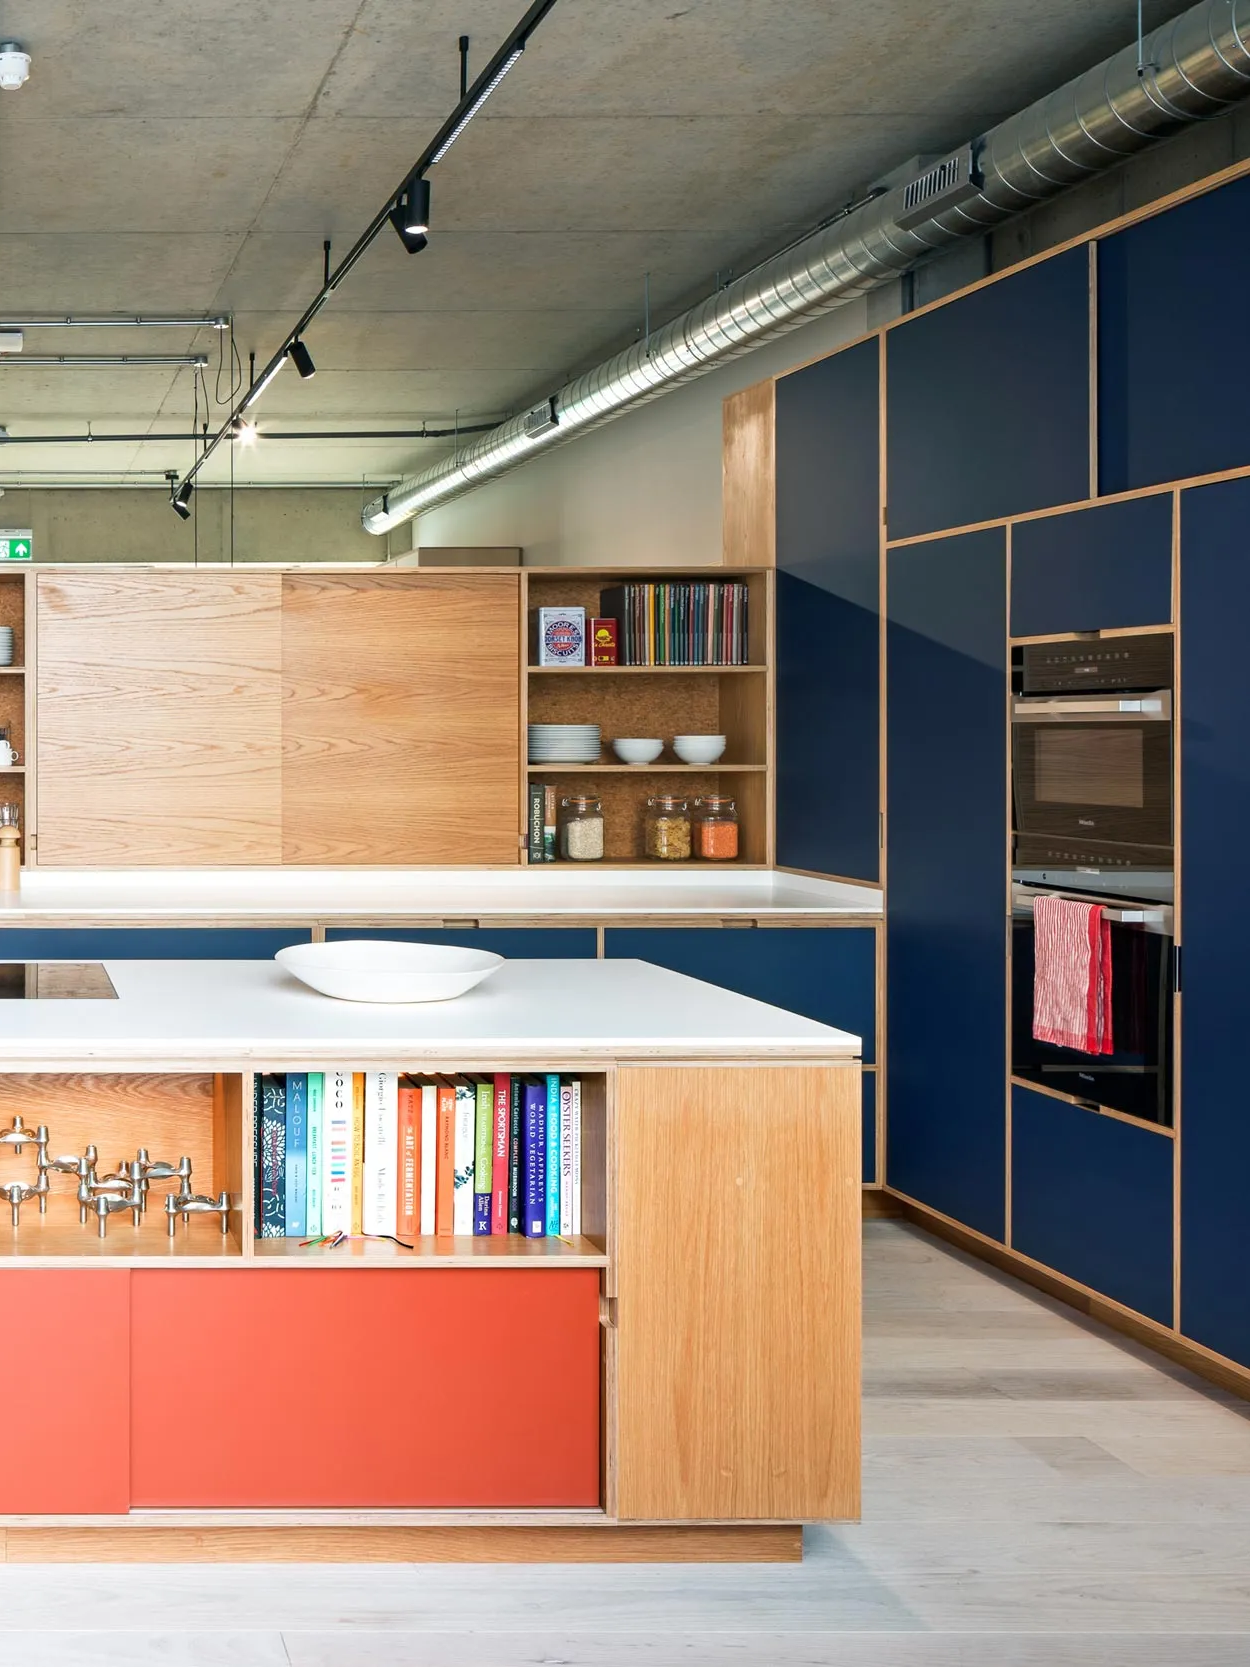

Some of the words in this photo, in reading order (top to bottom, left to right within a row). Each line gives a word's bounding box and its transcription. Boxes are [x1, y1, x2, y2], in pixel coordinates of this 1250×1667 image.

[547, 643, 579, 657] BISCUITS
[292, 1081, 302, 1148] MALOUF
[481, 1091, 491, 1109] Irish
[498, 1090, 506, 1105] THE
[562, 1091, 572, 1131] OYSTER
[406, 1135, 414, 1149] ART
[497, 1107, 506, 1157] SPORTSMAN
[477, 1157, 489, 1189] Cooking
[562, 1133, 571, 1177] SEEKERS
[406, 1158, 414, 1216] FERMENTATION
